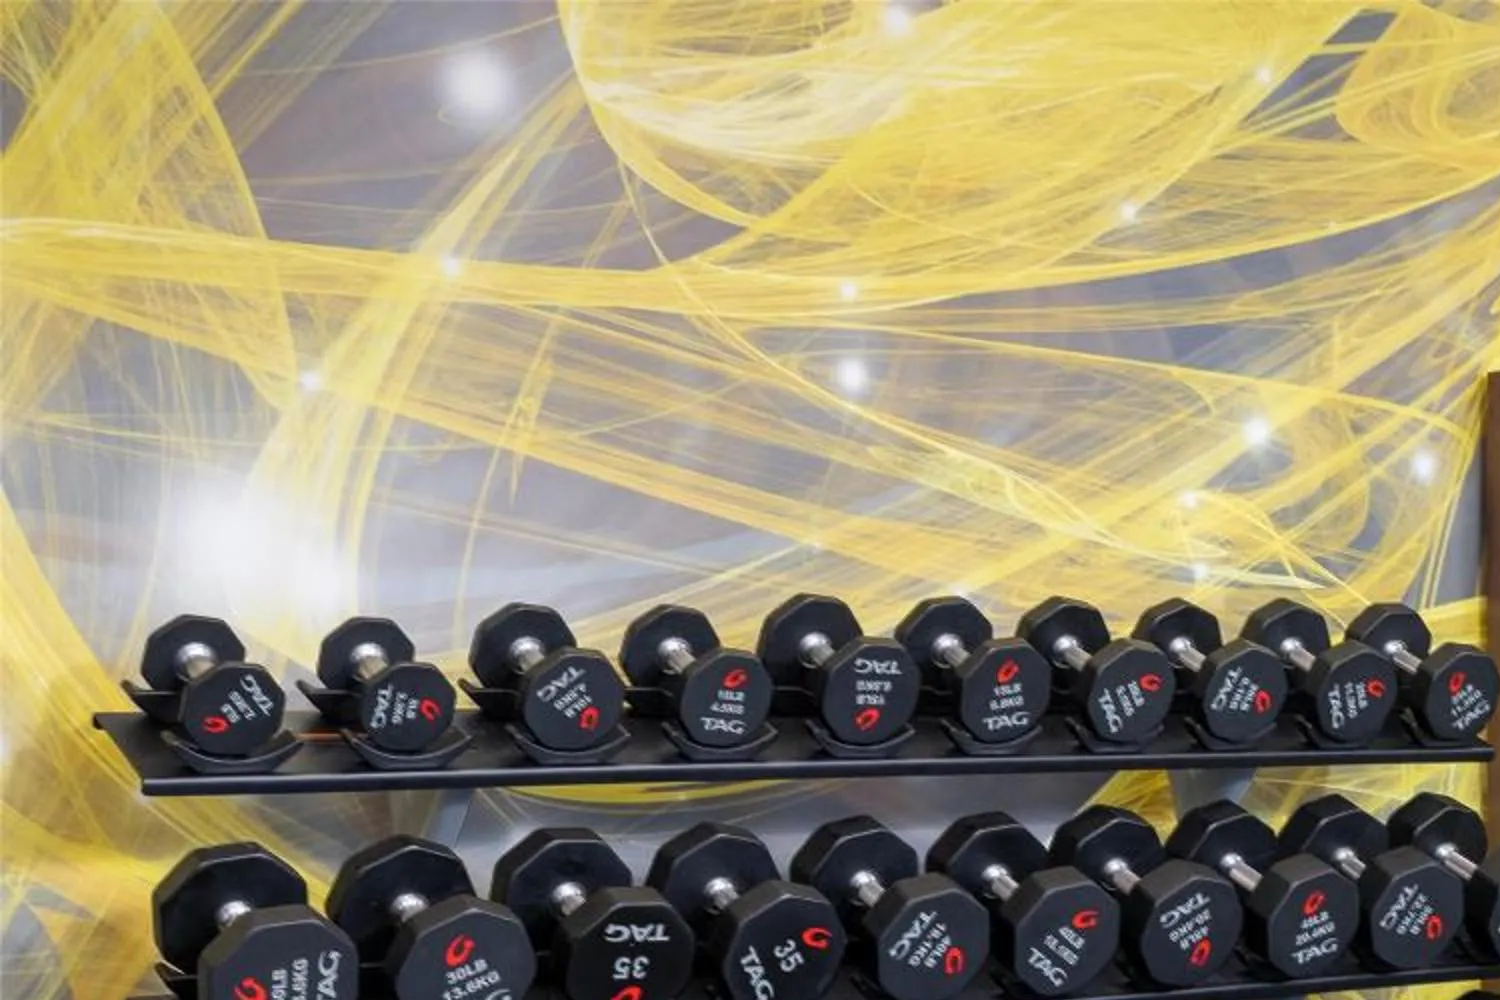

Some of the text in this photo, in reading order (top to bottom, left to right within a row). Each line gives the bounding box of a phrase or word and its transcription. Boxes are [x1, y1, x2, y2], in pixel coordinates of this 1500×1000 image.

[854, 658, 902, 675] TAG
[240, 674, 274, 717] TAG
[536, 666, 586, 702] TAG
[1211, 667, 1243, 711] TAG
[370, 684, 393, 728] TAG
[983, 711, 1030, 731] TAG
[1098, 688, 1122, 733] TAG
[1328, 683, 1345, 729] TAG
[1453, 699, 1490, 730] TAG
[701, 717, 745, 735] TAG
[1160, 894, 1210, 928] TAG
[1380, 884, 1419, 930] TAG
[605, 923, 669, 942] TAG
[889, 911, 937, 960] TAG
[613, 956, 649, 980] 35
[774, 940, 804, 972] 35
[1027, 947, 1068, 987] TAG
[1292, 938, 1338, 964] TAG
[446, 960, 488, 984] 30LB
